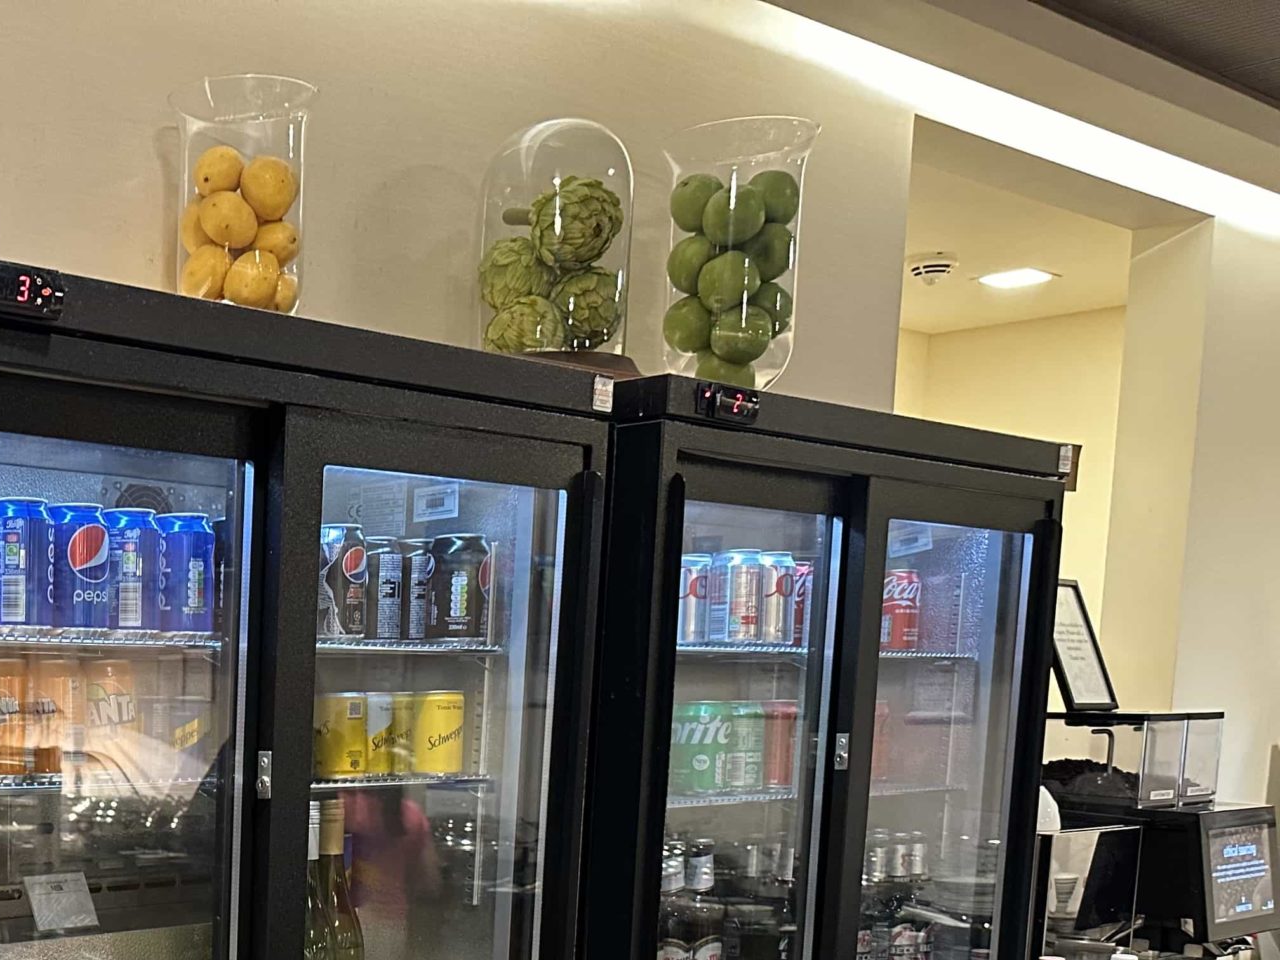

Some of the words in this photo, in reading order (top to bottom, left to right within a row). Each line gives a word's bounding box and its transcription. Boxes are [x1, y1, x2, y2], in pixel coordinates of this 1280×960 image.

[16, 275, 31, 302] 3
[73, 588, 109, 605] peps
[88, 692, 137, 728] ANTA
[427, 724, 464, 751] Schwepp
